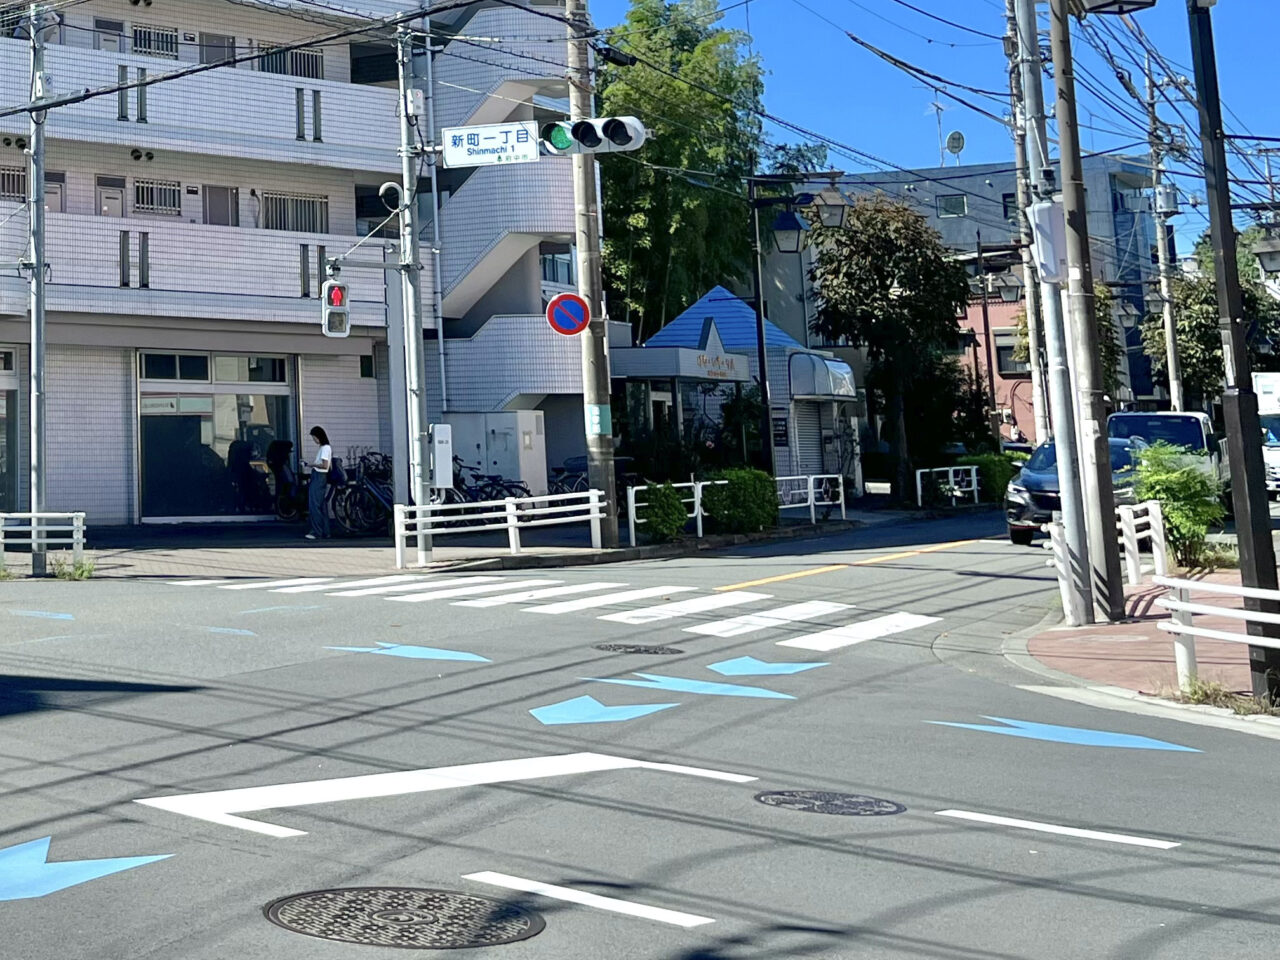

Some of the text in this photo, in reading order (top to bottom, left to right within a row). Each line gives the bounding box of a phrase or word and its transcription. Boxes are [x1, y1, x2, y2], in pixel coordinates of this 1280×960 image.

[451, 129, 529, 149] 新町一丁目
[467, 145, 507, 156] Shinmachi
